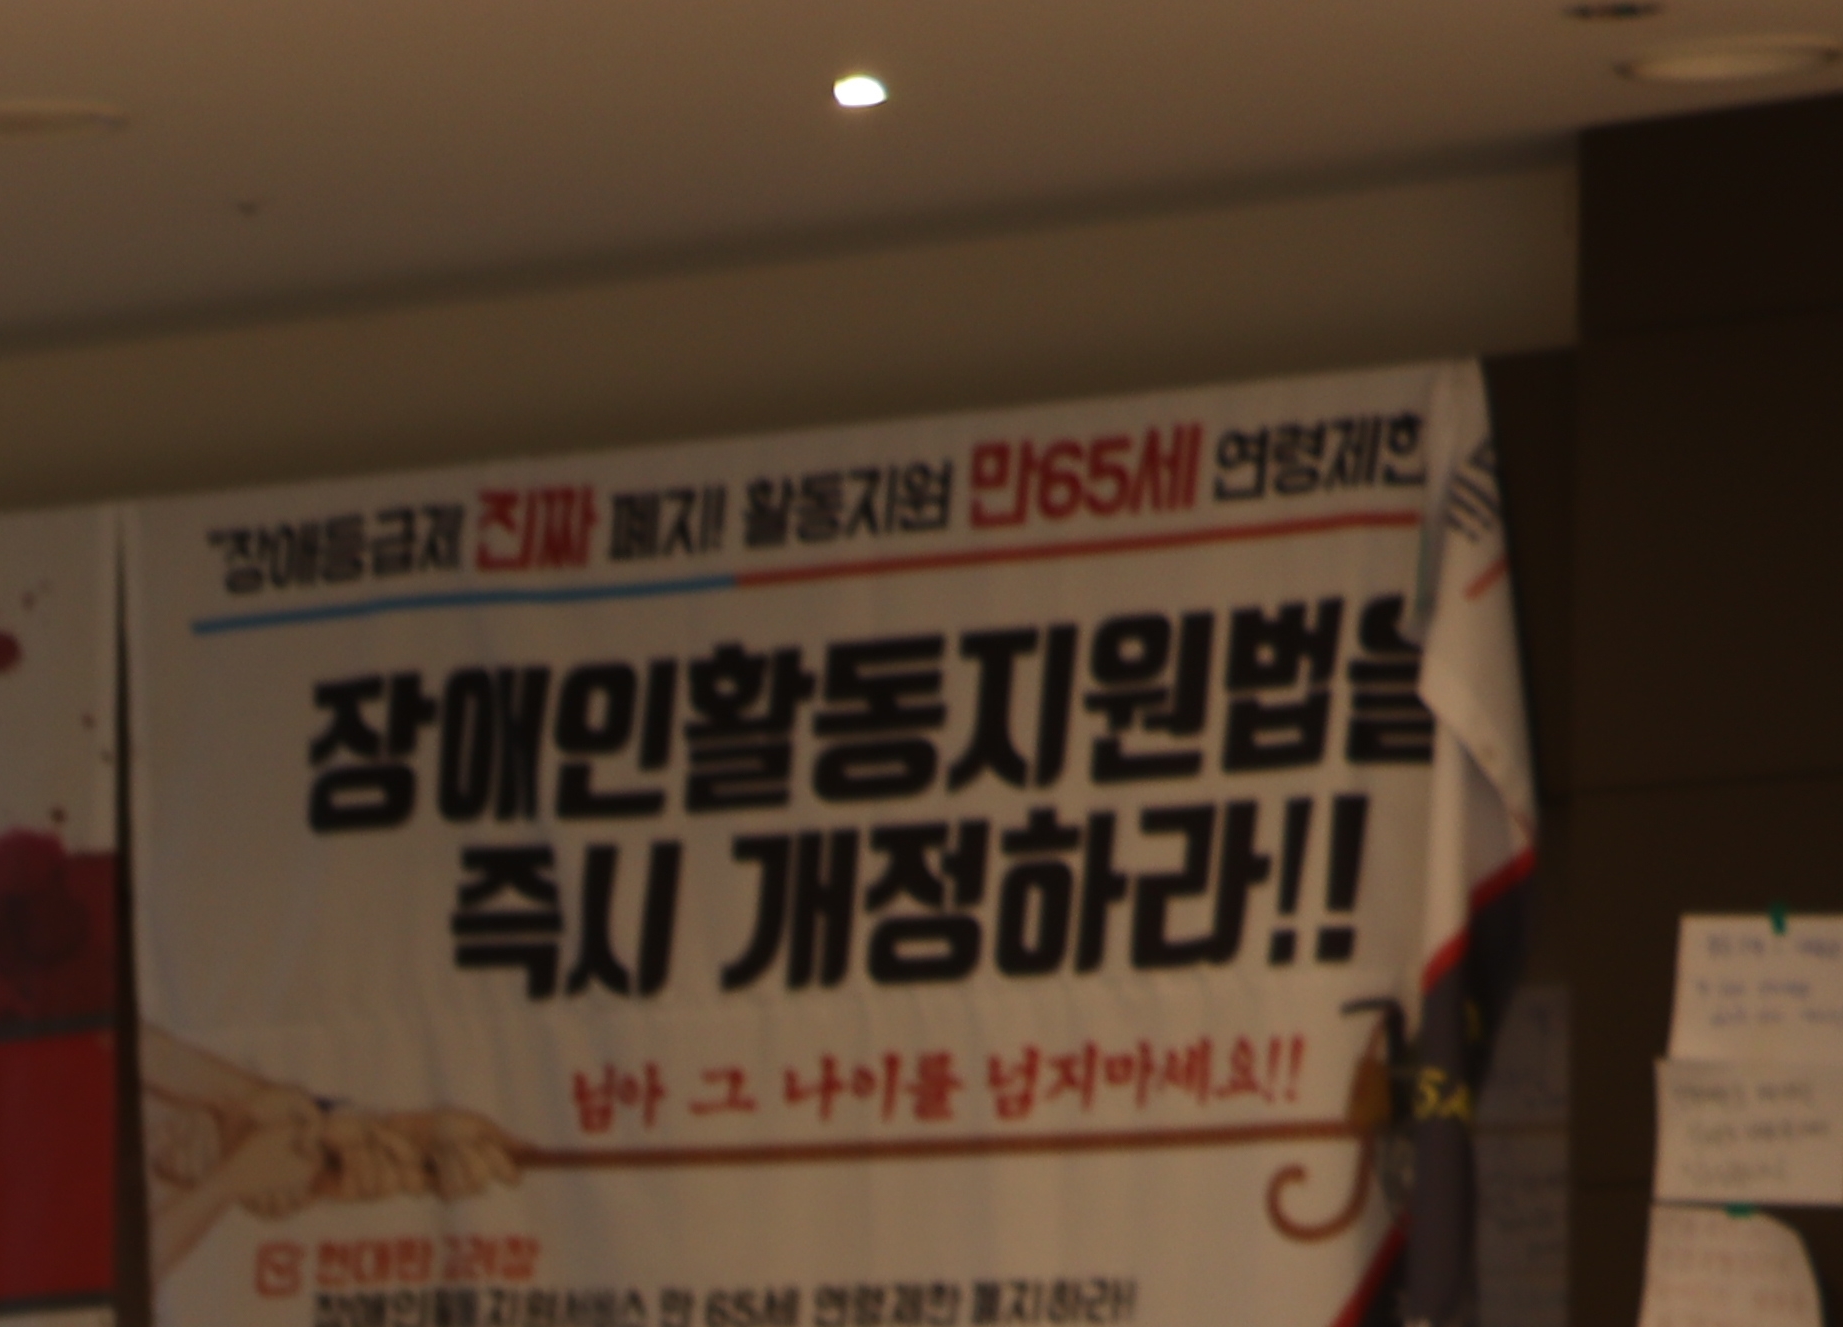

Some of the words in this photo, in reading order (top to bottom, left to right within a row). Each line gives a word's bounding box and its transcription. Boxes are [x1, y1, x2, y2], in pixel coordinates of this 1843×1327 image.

[478, 485, 596, 573] 진짜
[742, 460, 952, 547] 활동지원
[451, 839, 685, 998] 즉시
[724, 794, 1372, 990] 개정하라!!
[688, 1063, 758, 1116] 그
[783, 1052, 958, 1123] 나이를
[987, 1034, 1306, 1121] 넘지마세요!!
